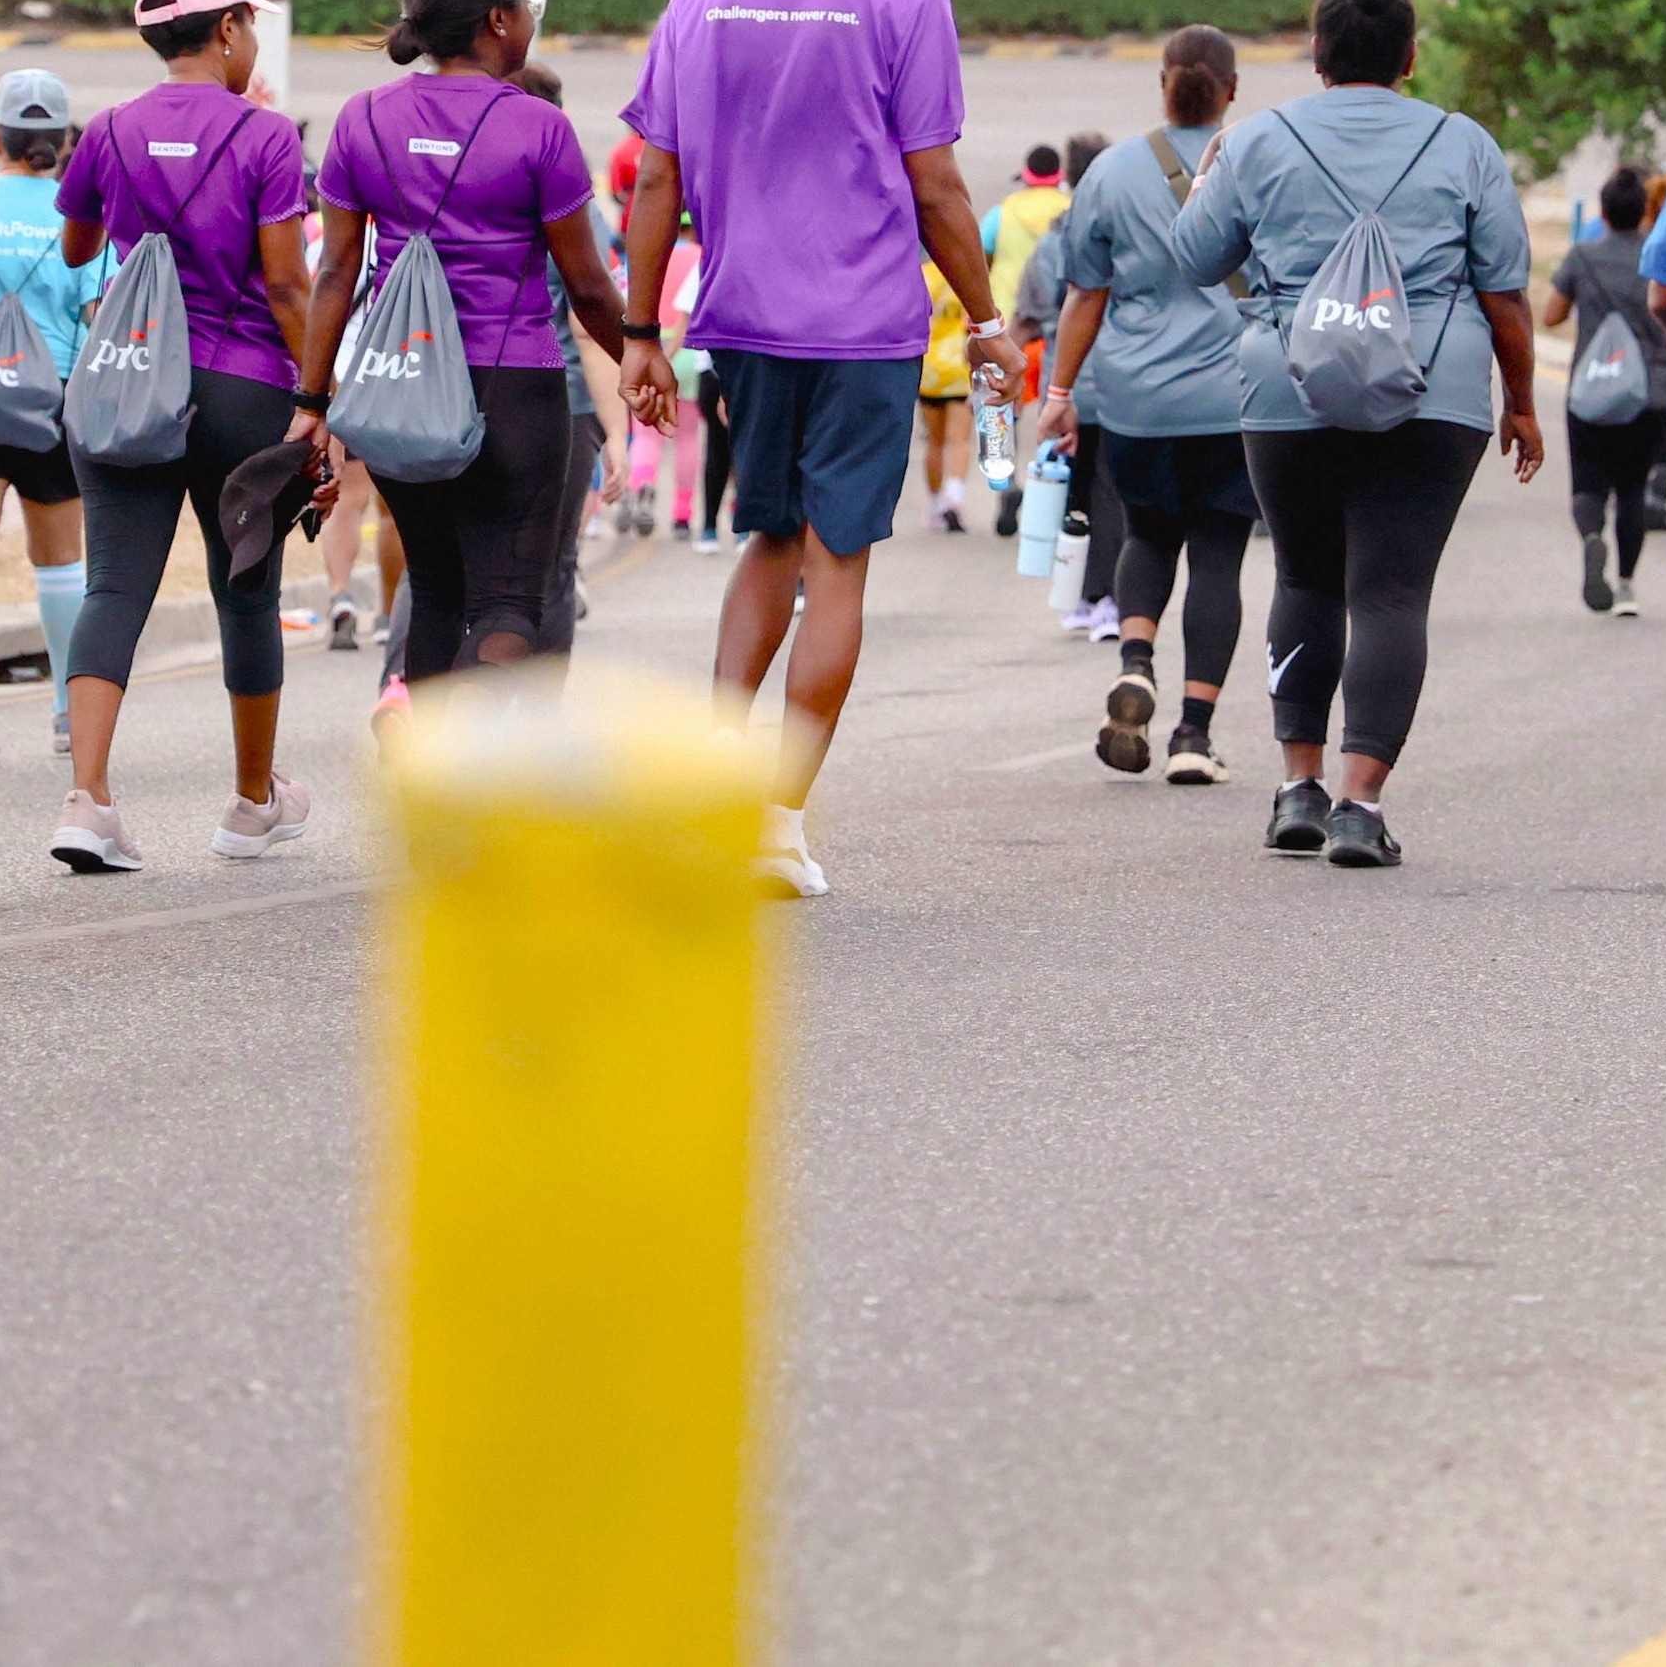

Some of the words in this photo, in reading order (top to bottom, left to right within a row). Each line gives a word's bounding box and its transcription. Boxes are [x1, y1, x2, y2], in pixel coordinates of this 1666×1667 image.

[790, 10, 827, 22] never
[827, 11, 860, 26] rest.
[151, 145, 191, 153] DENTONS
[413, 142, 454, 152] DENTONS
[1309, 297, 1392, 332] pwc
[354, 347, 421, 384] pwc
